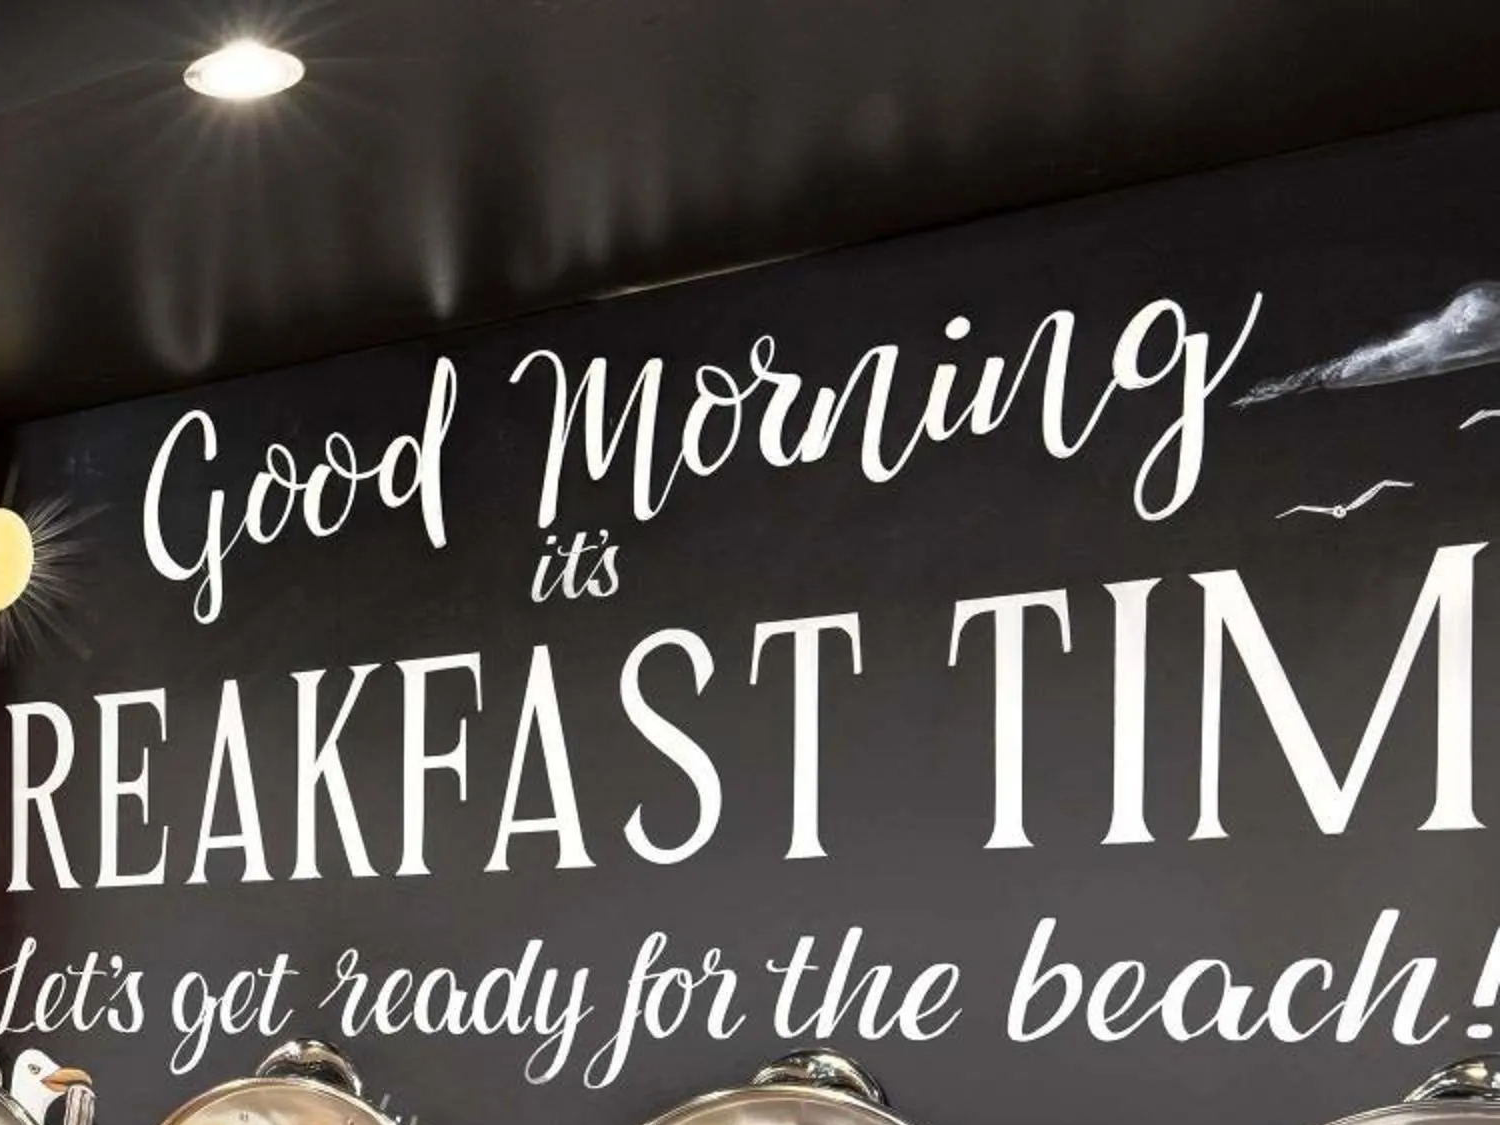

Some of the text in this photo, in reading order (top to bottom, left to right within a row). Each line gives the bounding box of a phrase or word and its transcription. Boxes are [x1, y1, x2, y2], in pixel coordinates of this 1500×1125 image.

[142, 290, 1264, 625] Good Morning
[530, 528, 621, 603] it's
[947, 540, 1490, 850] TIM
[169, 952, 301, 1077] get
[319, 938, 594, 1087] ready
[582, 930, 746, 1090] for
[766, 926, 963, 1041] the
[1006, 908, 1500, 1046] beach!
